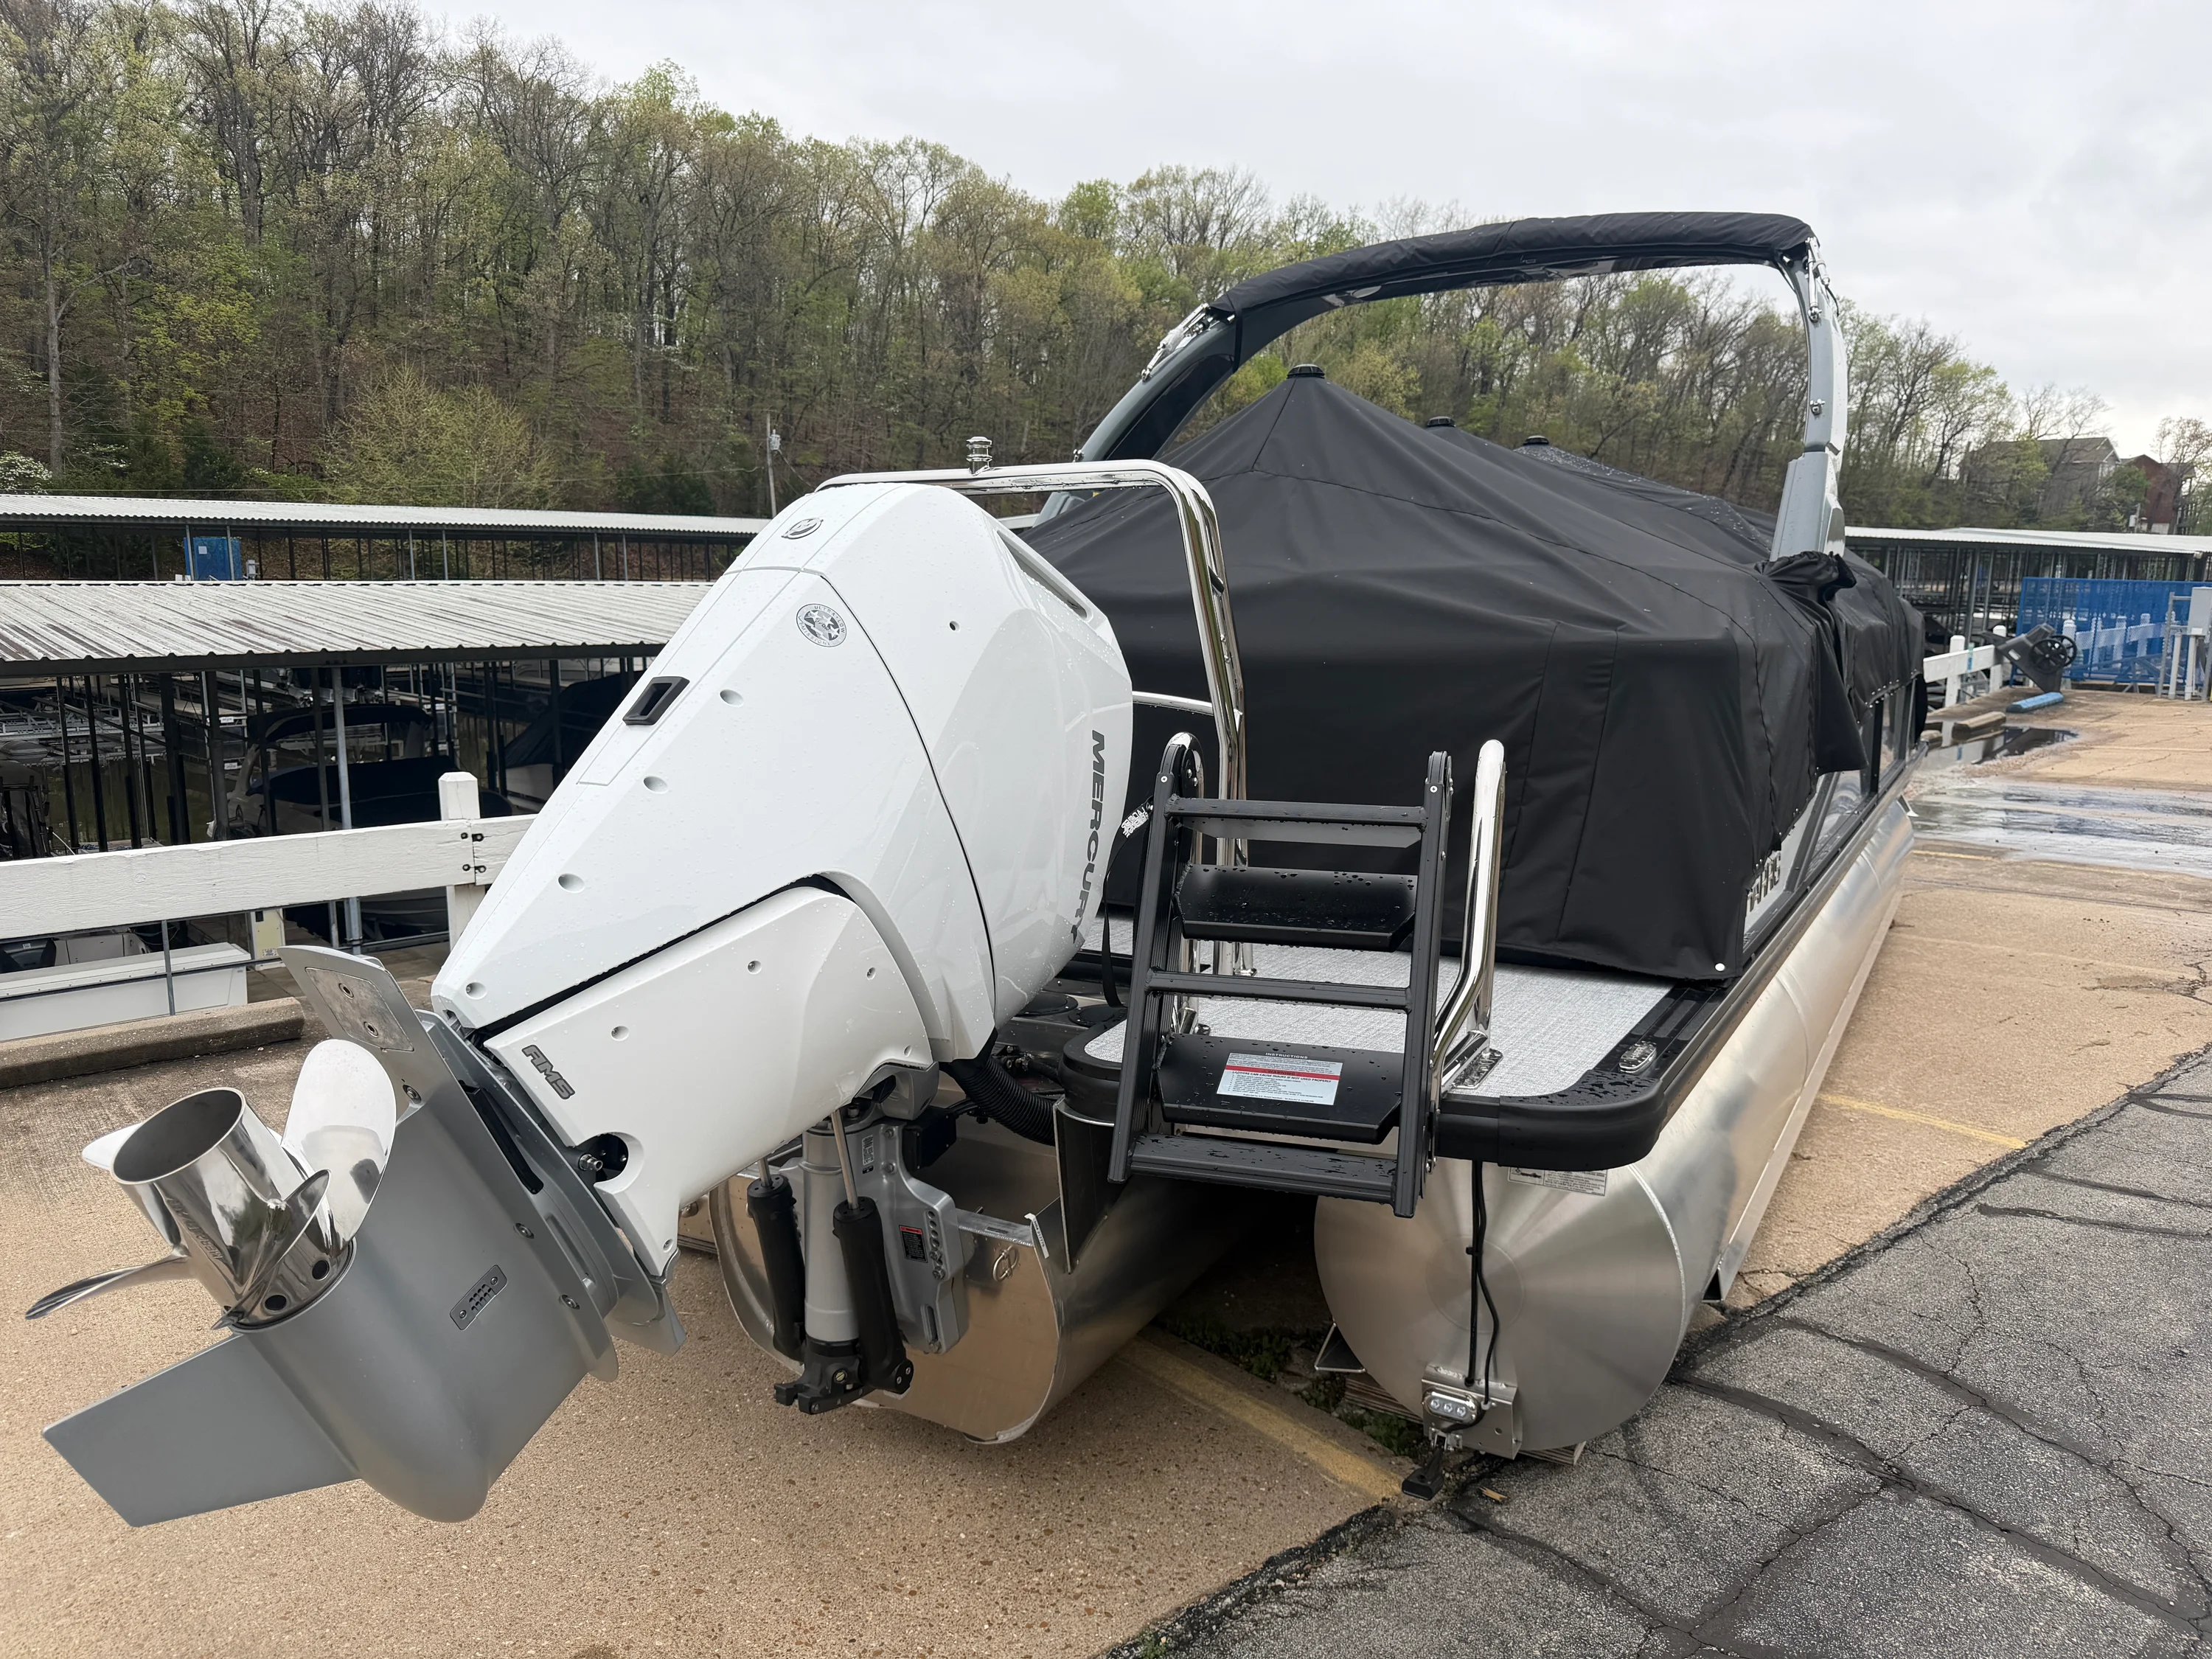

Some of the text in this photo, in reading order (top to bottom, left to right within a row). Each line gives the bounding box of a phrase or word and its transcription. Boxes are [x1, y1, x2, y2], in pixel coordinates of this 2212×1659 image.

[814, 605, 835, 616] ULTRA
[837, 619, 845, 633] LOW
[1071, 730, 1105, 944] MERCURY
[521, 1045, 576, 1100] AMS
